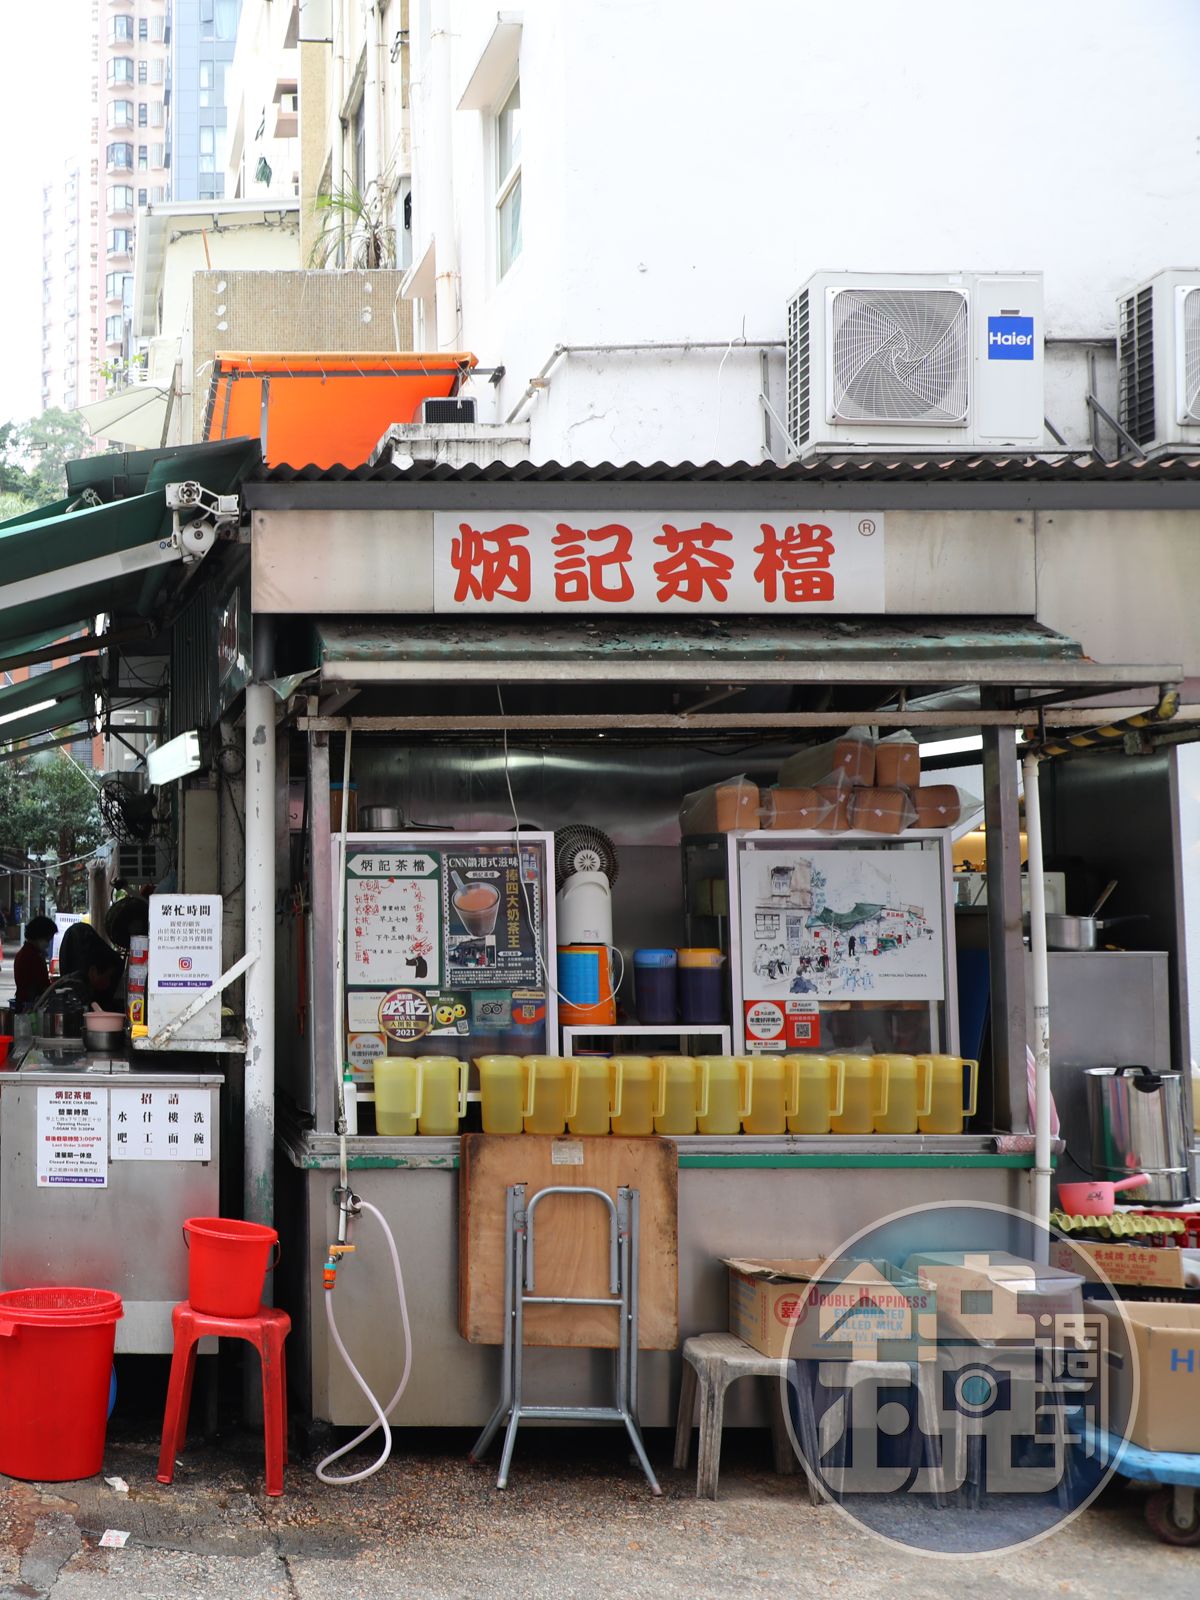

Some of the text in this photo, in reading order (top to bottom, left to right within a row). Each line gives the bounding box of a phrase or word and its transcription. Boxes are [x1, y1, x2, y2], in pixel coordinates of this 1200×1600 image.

[989, 331, 1033, 346] Haier
[451, 521, 836, 603] 炳記茶檔
[360, 859, 426, 872] 炳記茶檔
[161, 904, 211, 917] 繁忙時間
[379, 915, 409, 924] 早上七時
[382, 999, 430, 1015] 必吃
[55, 1091, 92, 1100] 炳記茶檔
[58, 1108, 89, 1116] 營業時間
[809, 1286, 856, 1308] DOUBLE
[858, 1287, 928, 1309] HAPPINESS
[833, 1308, 905, 1320] EVAPORATED
[876, 1320, 904, 1331] MILK
[1171, 1349, 1200, 1373] H
